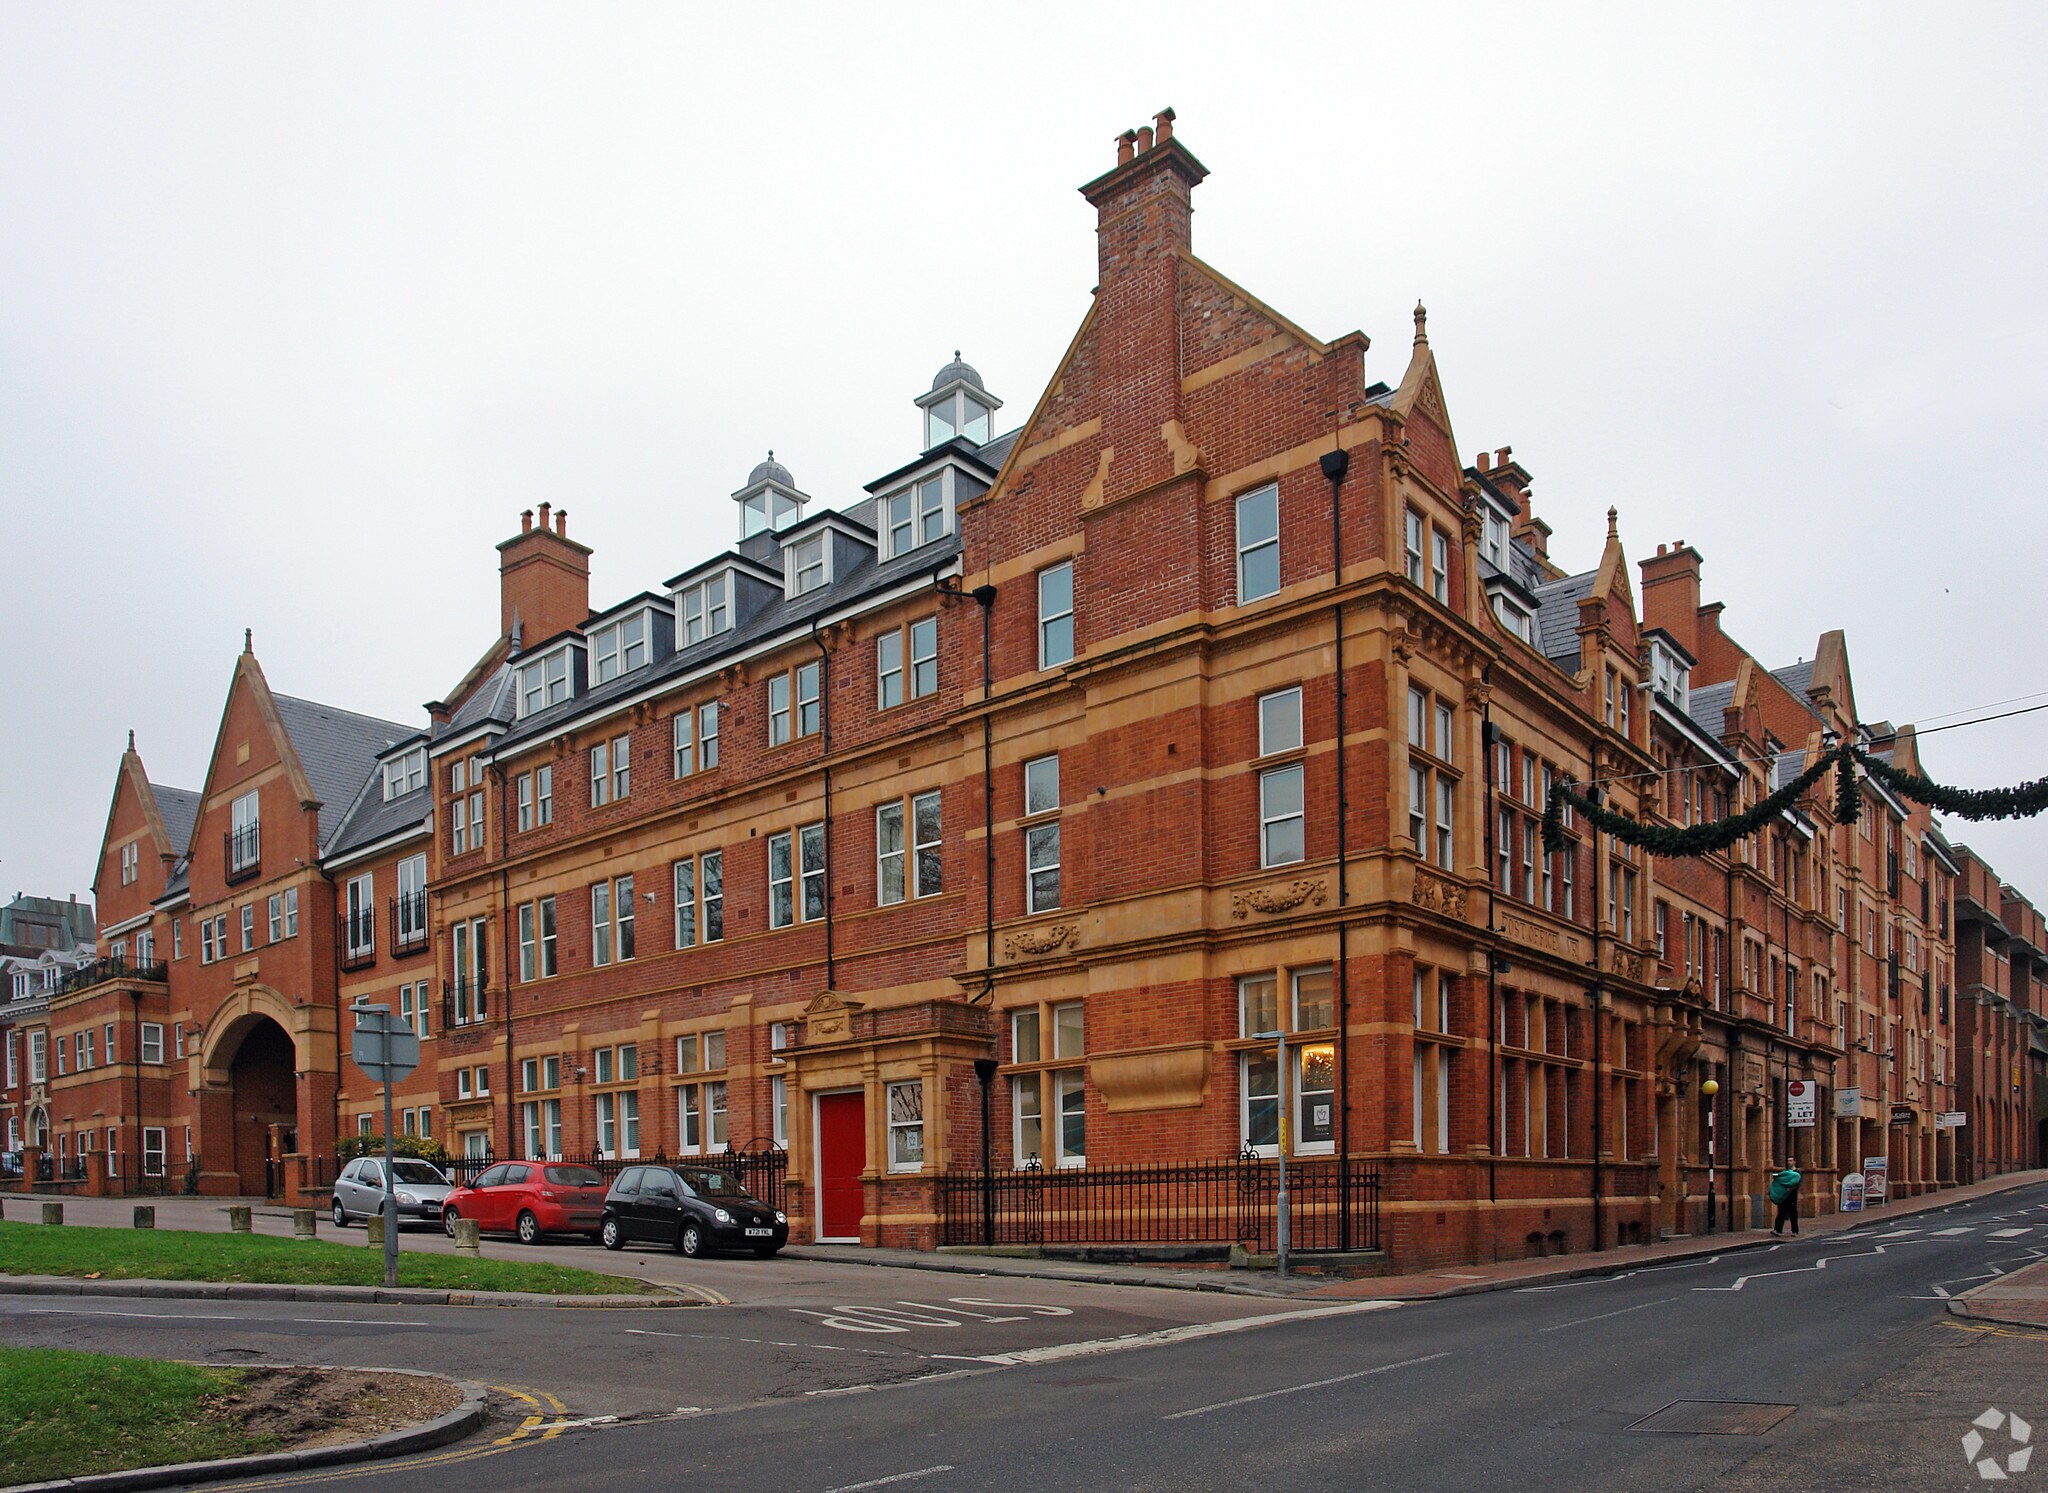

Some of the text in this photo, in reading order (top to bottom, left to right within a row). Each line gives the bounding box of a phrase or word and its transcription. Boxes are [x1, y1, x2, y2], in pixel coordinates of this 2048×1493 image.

[1502, 915, 1526, 939] POST
[1528, 925, 1559, 950] OFFICE
[789, 1298, 1074, 1333] STOP
